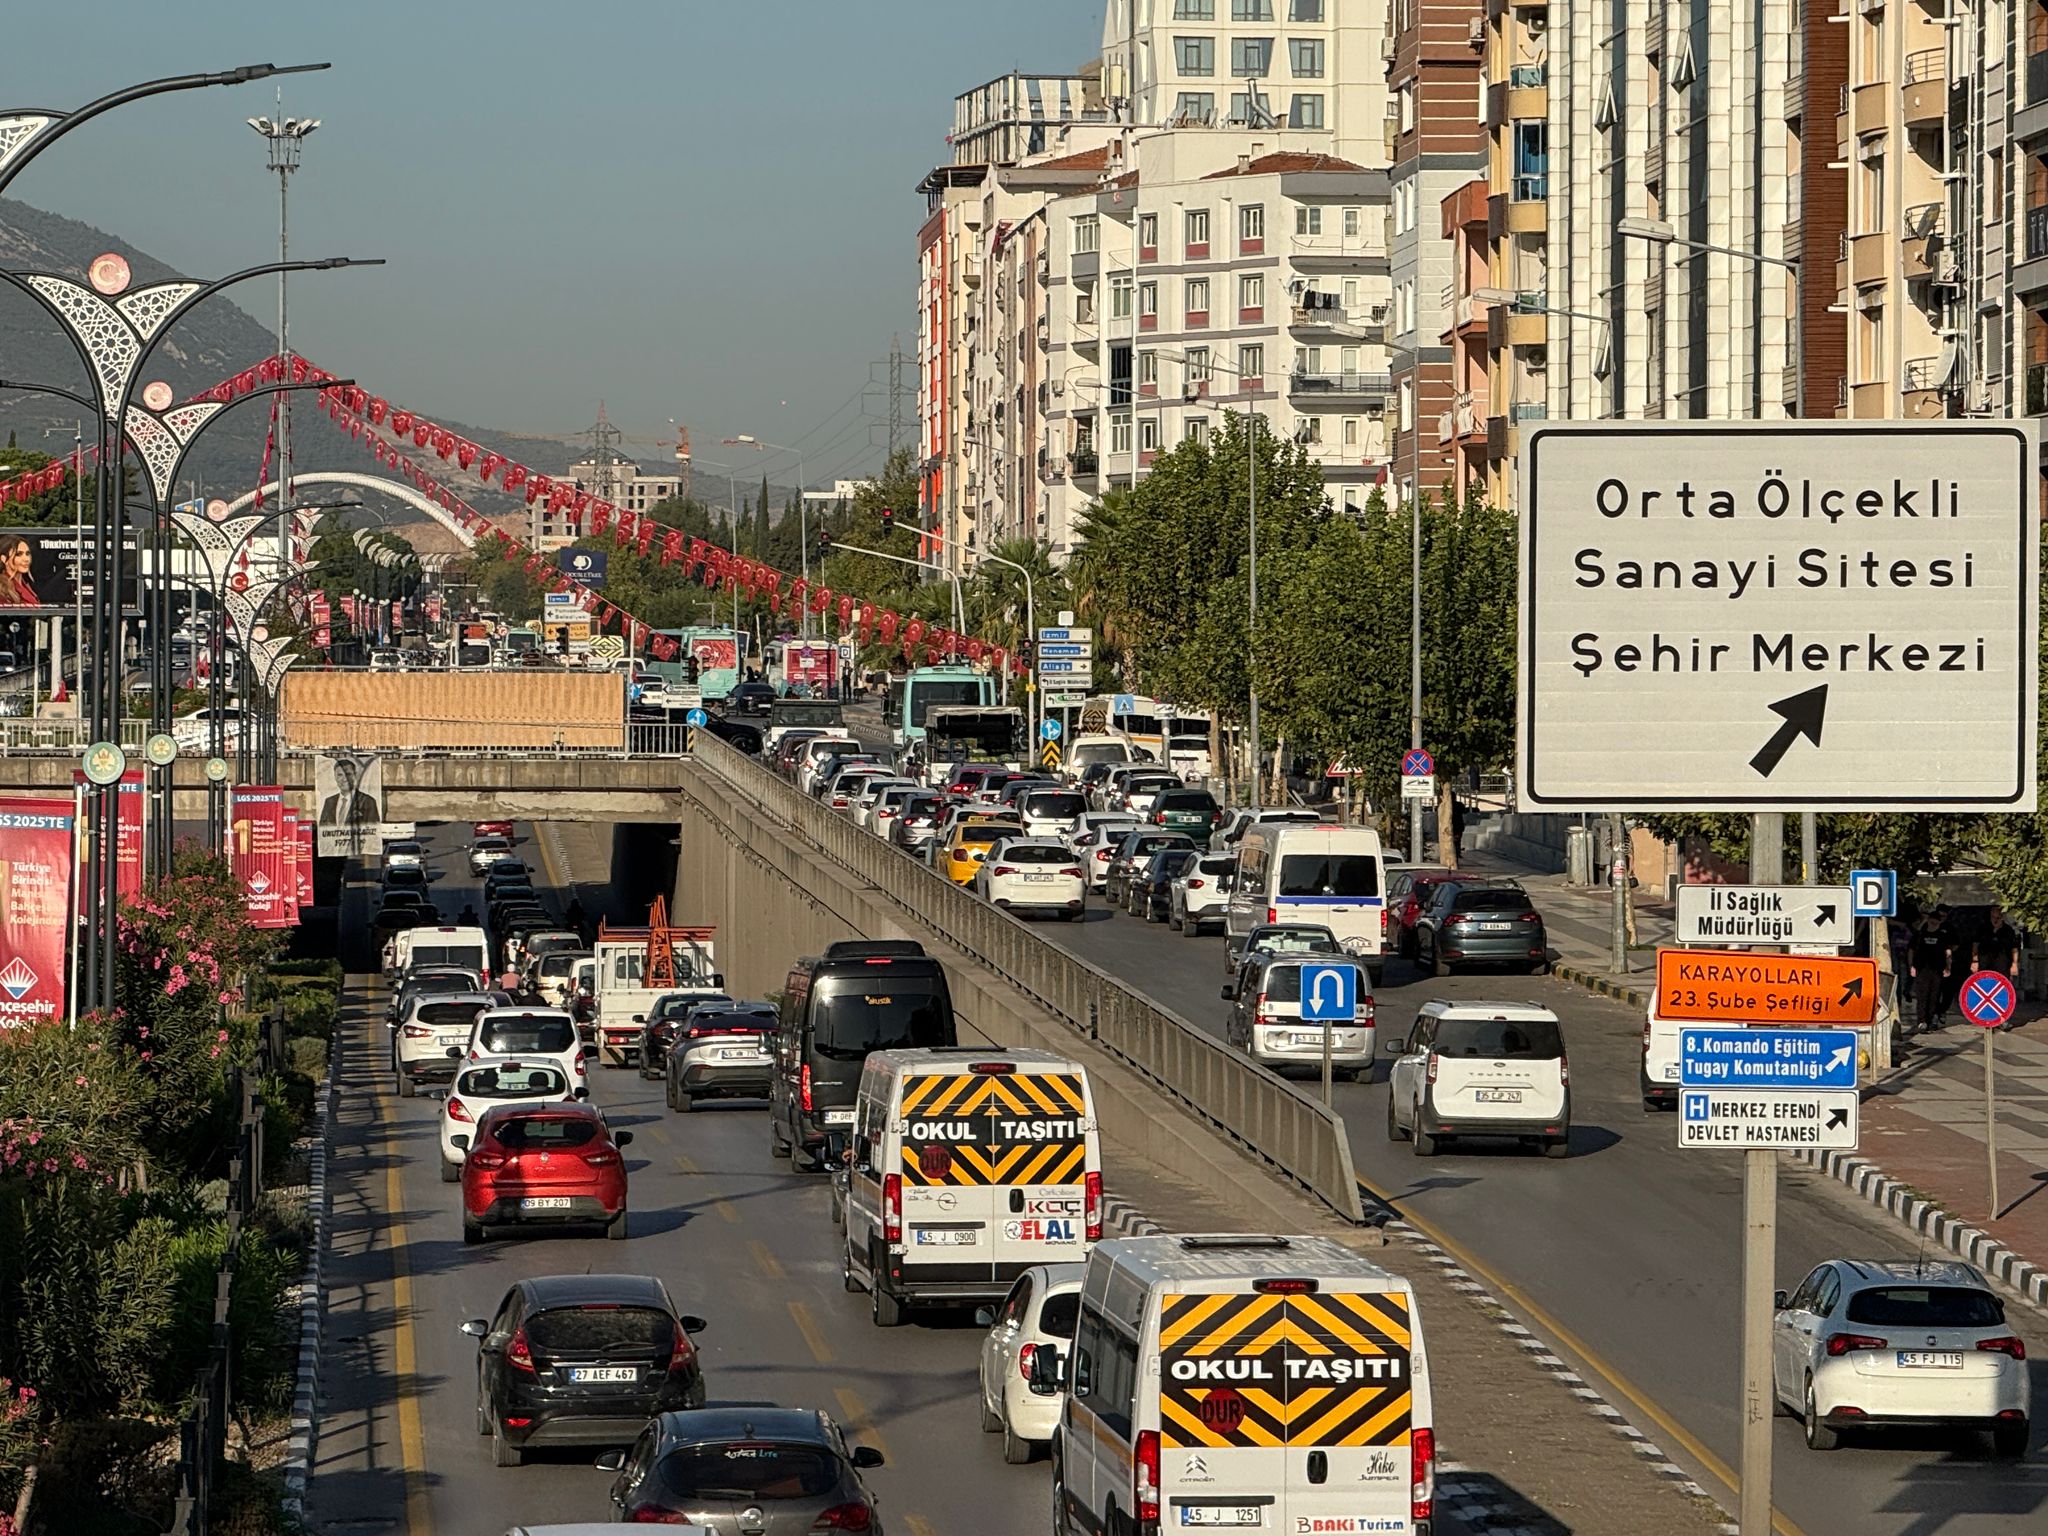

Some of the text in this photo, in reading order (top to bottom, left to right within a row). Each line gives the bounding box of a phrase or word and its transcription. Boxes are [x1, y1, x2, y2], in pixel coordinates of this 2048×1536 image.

[1597, 469, 1959, 524] Orta Ölçekli
[1574, 548, 1974, 600] Sanayi Sitesi
[1570, 632, 1985, 678] Şehir Merkezi
[13, 815, 65, 829] 2025'TE
[12, 861, 51, 875] Türkiye
[1710, 887, 1783, 916] İl Sağlık
[1863, 881, 1883, 906] D
[1697, 916, 1793, 941] Müdürlüğü
[1679, 964, 1821, 986] KARAYOLLARI
[1669, 990, 1830, 1015] 23. Şube Şefliği
[1773, 1038, 1821, 1058] Eğitim
[1685, 1058, 1823, 1080] Tugay Komutanlığı
[1689, 1098, 1821, 1119] H MERKEZ EFENDİ
[911, 1120, 1075, 1142] OKUL TAŞITI
[1687, 1124, 1820, 1142] DEVLET HASTANESİ
[923, 1153, 949, 1169] DUR
[553, 1198, 569, 1207] 207
[1028, 1200, 1081, 1216] KOÇ
[922, 1232, 975, 1242] 45 J 0900
[1903, 1353, 1961, 1365] 45 FJ 115
[575, 1368, 635, 1381] 27 AEF 467
[1170, 1358, 1400, 1384] OKUL TAŞITI
[1202, 1398, 1241, 1424] DUR
[1188, 1508, 1259, 1521] 45 J 1251
[1358, 1518, 1404, 1530] Turizm
